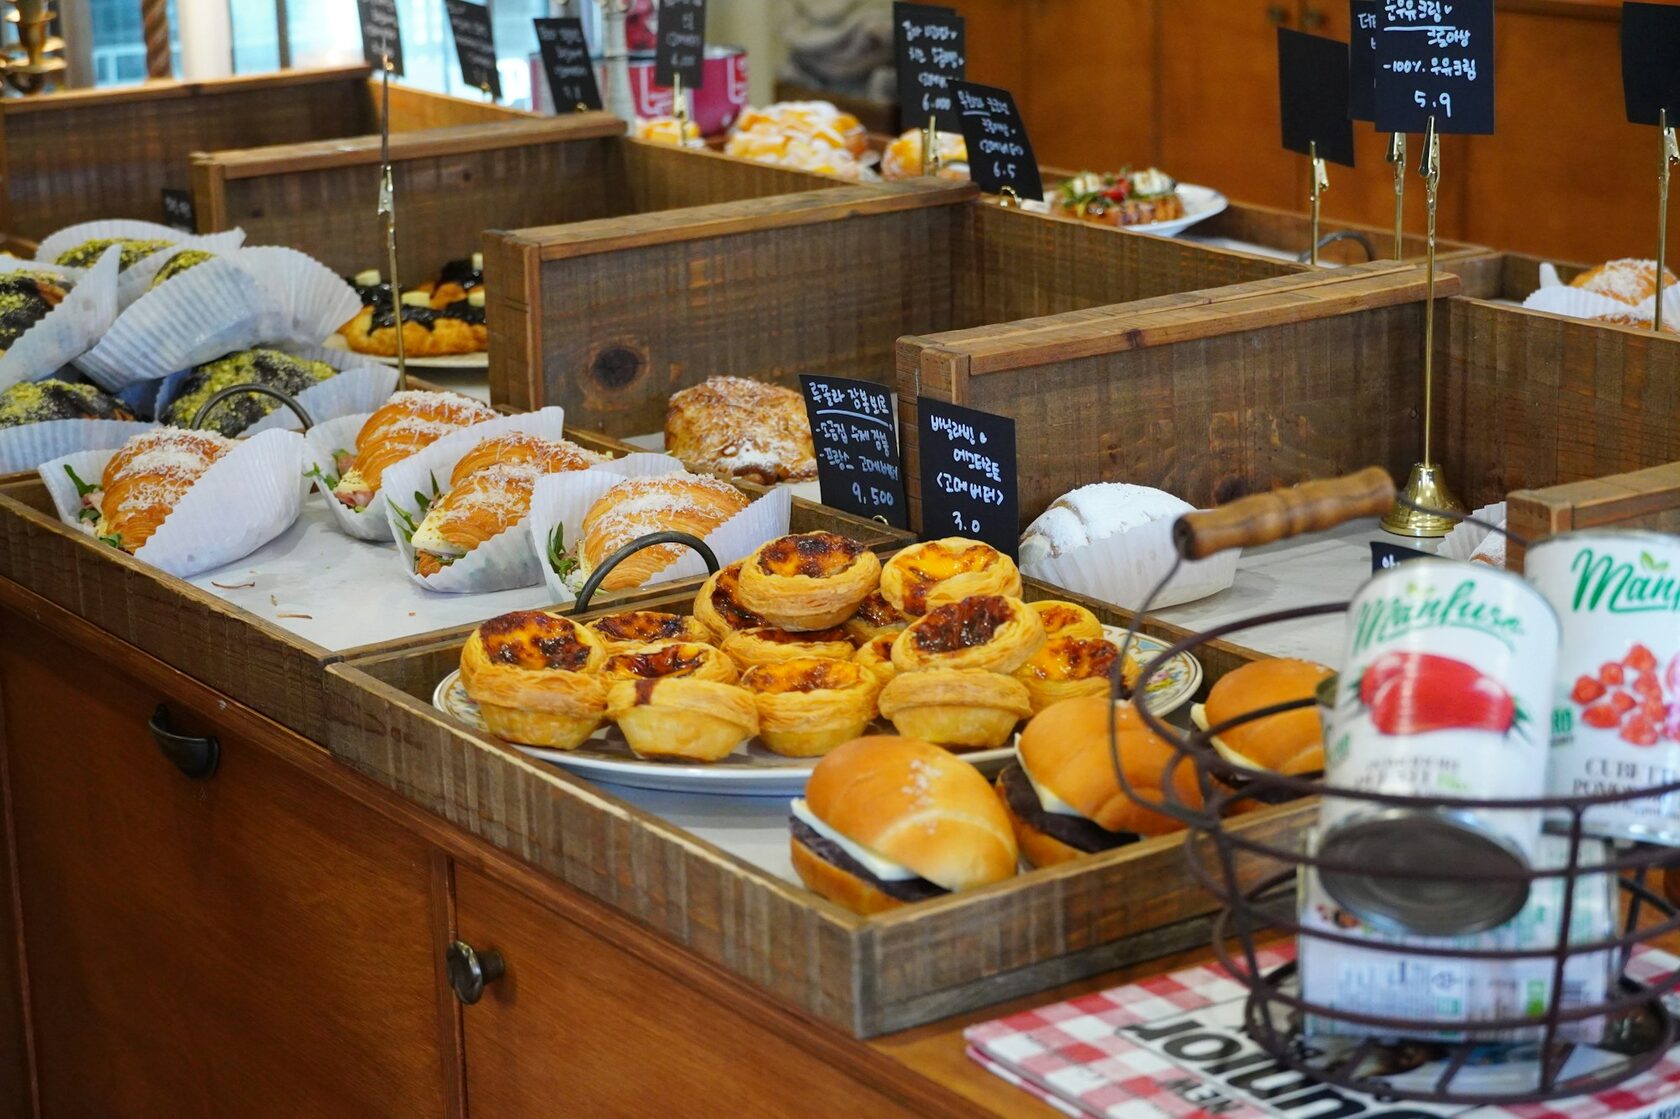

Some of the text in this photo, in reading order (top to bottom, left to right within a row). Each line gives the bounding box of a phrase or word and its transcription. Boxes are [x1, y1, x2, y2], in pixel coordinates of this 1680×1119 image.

[1430, 57, 1477, 81] 우유크림
[1414, 89, 1452, 118] 5.9
[993, 161, 1016, 179] 6.5
[851, 424, 870, 442] 수제
[870, 429, 890, 457] 잠봉
[930, 414, 976, 445] 바닐라빈
[858, 455, 898, 480] 고메버터
[852, 481, 894, 506] 9,500
[952, 510, 980, 533] 3.0
